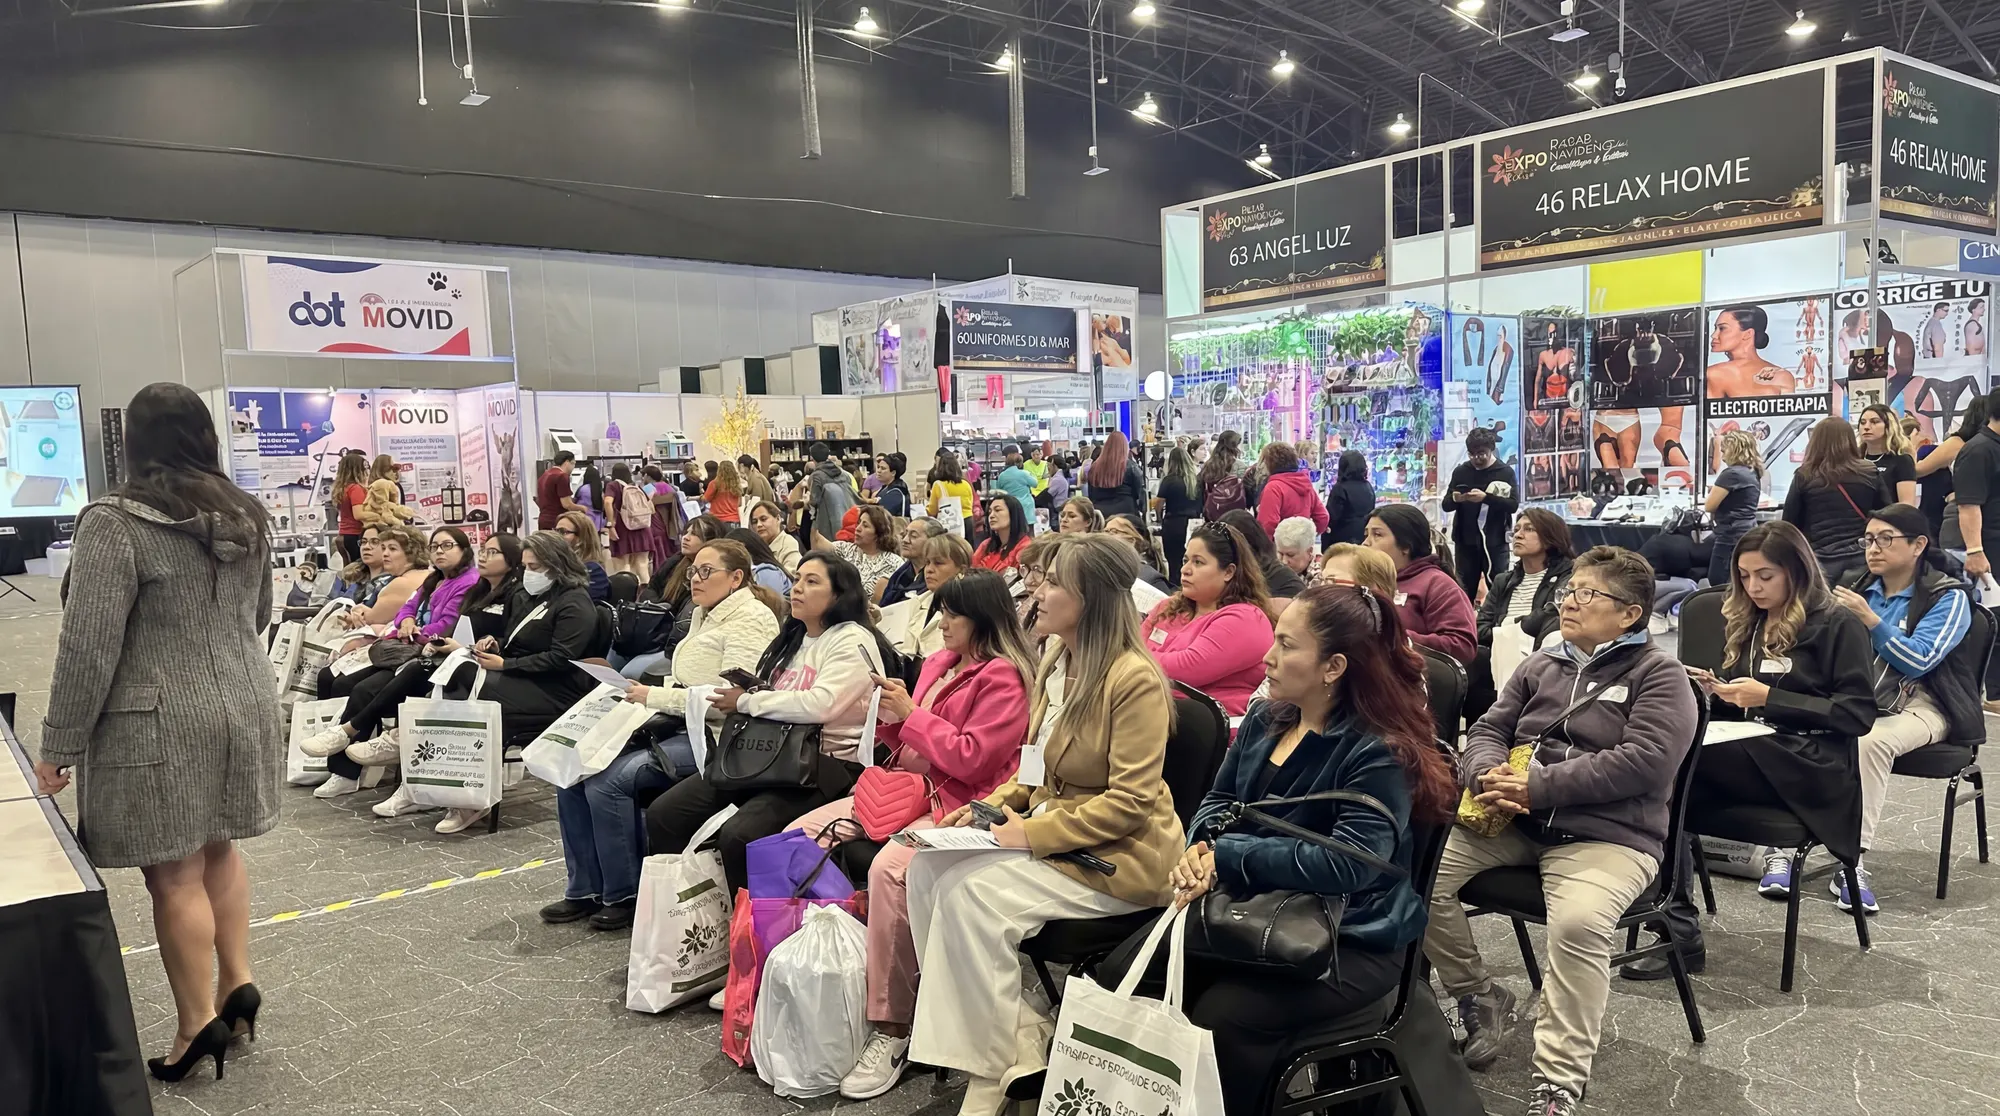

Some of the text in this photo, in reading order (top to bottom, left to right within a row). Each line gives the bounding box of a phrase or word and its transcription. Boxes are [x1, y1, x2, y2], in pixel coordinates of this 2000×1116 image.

[1889, 137, 1987, 184] 46 RELAX HOME
[1535, 189, 1565, 216] 46
[1572, 174, 1651, 211] RELAX
[1660, 156, 1750, 196] HOME
[1229, 225, 1352, 267] 63 ANGEL LUZ
[1836, 279, 1985, 309] CORRIGE TU
[362, 305, 454, 330] MOVID
[957, 331, 1070, 349] 60UNIFORMES DI & MAR
[381, 407, 449, 425] MOVID
[487, 398, 516, 418] MOVID
[1709, 396, 1828, 416] ELECTROTERAPIA
